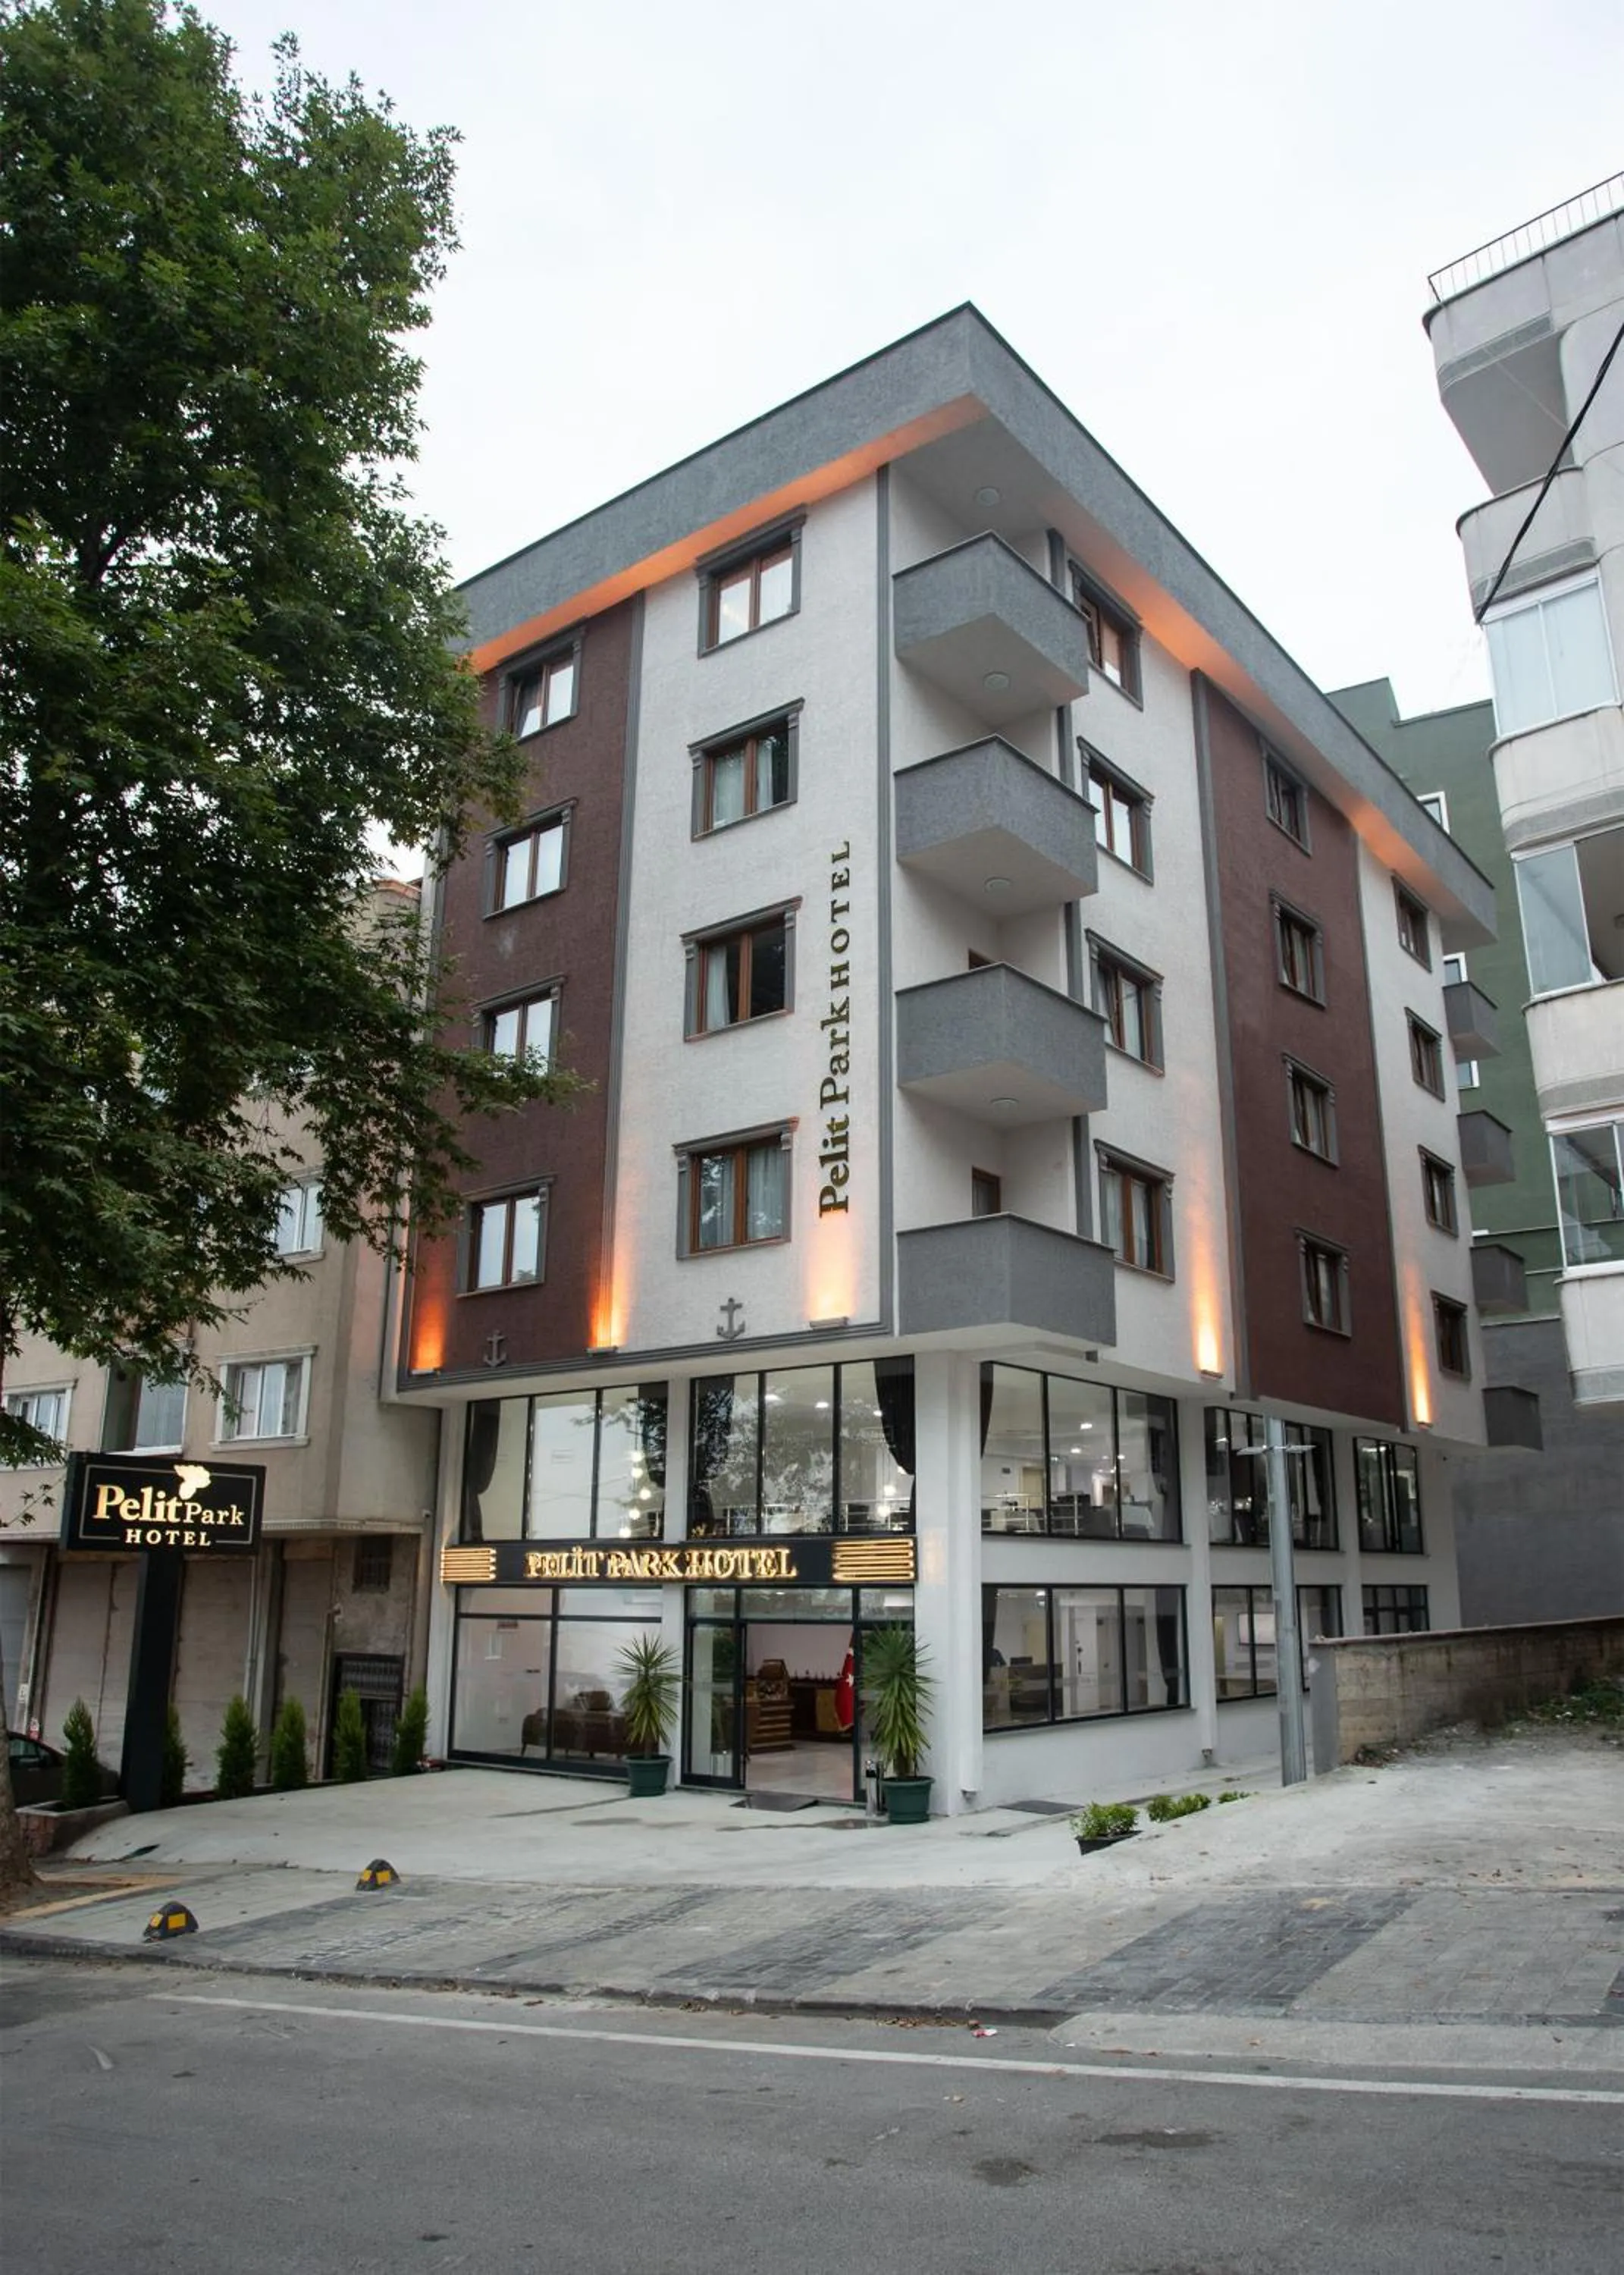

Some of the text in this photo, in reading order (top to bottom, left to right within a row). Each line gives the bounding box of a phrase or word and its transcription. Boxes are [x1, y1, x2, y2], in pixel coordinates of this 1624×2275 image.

[819, 840, 850, 1218] Pelit Park HOTEL
[92, 1484, 245, 1526] Pelit Park
[125, 1528, 212, 1546] HOTEL
[605, 1548, 683, 1578] PARK
[684, 1547, 798, 1578] HOTEL
